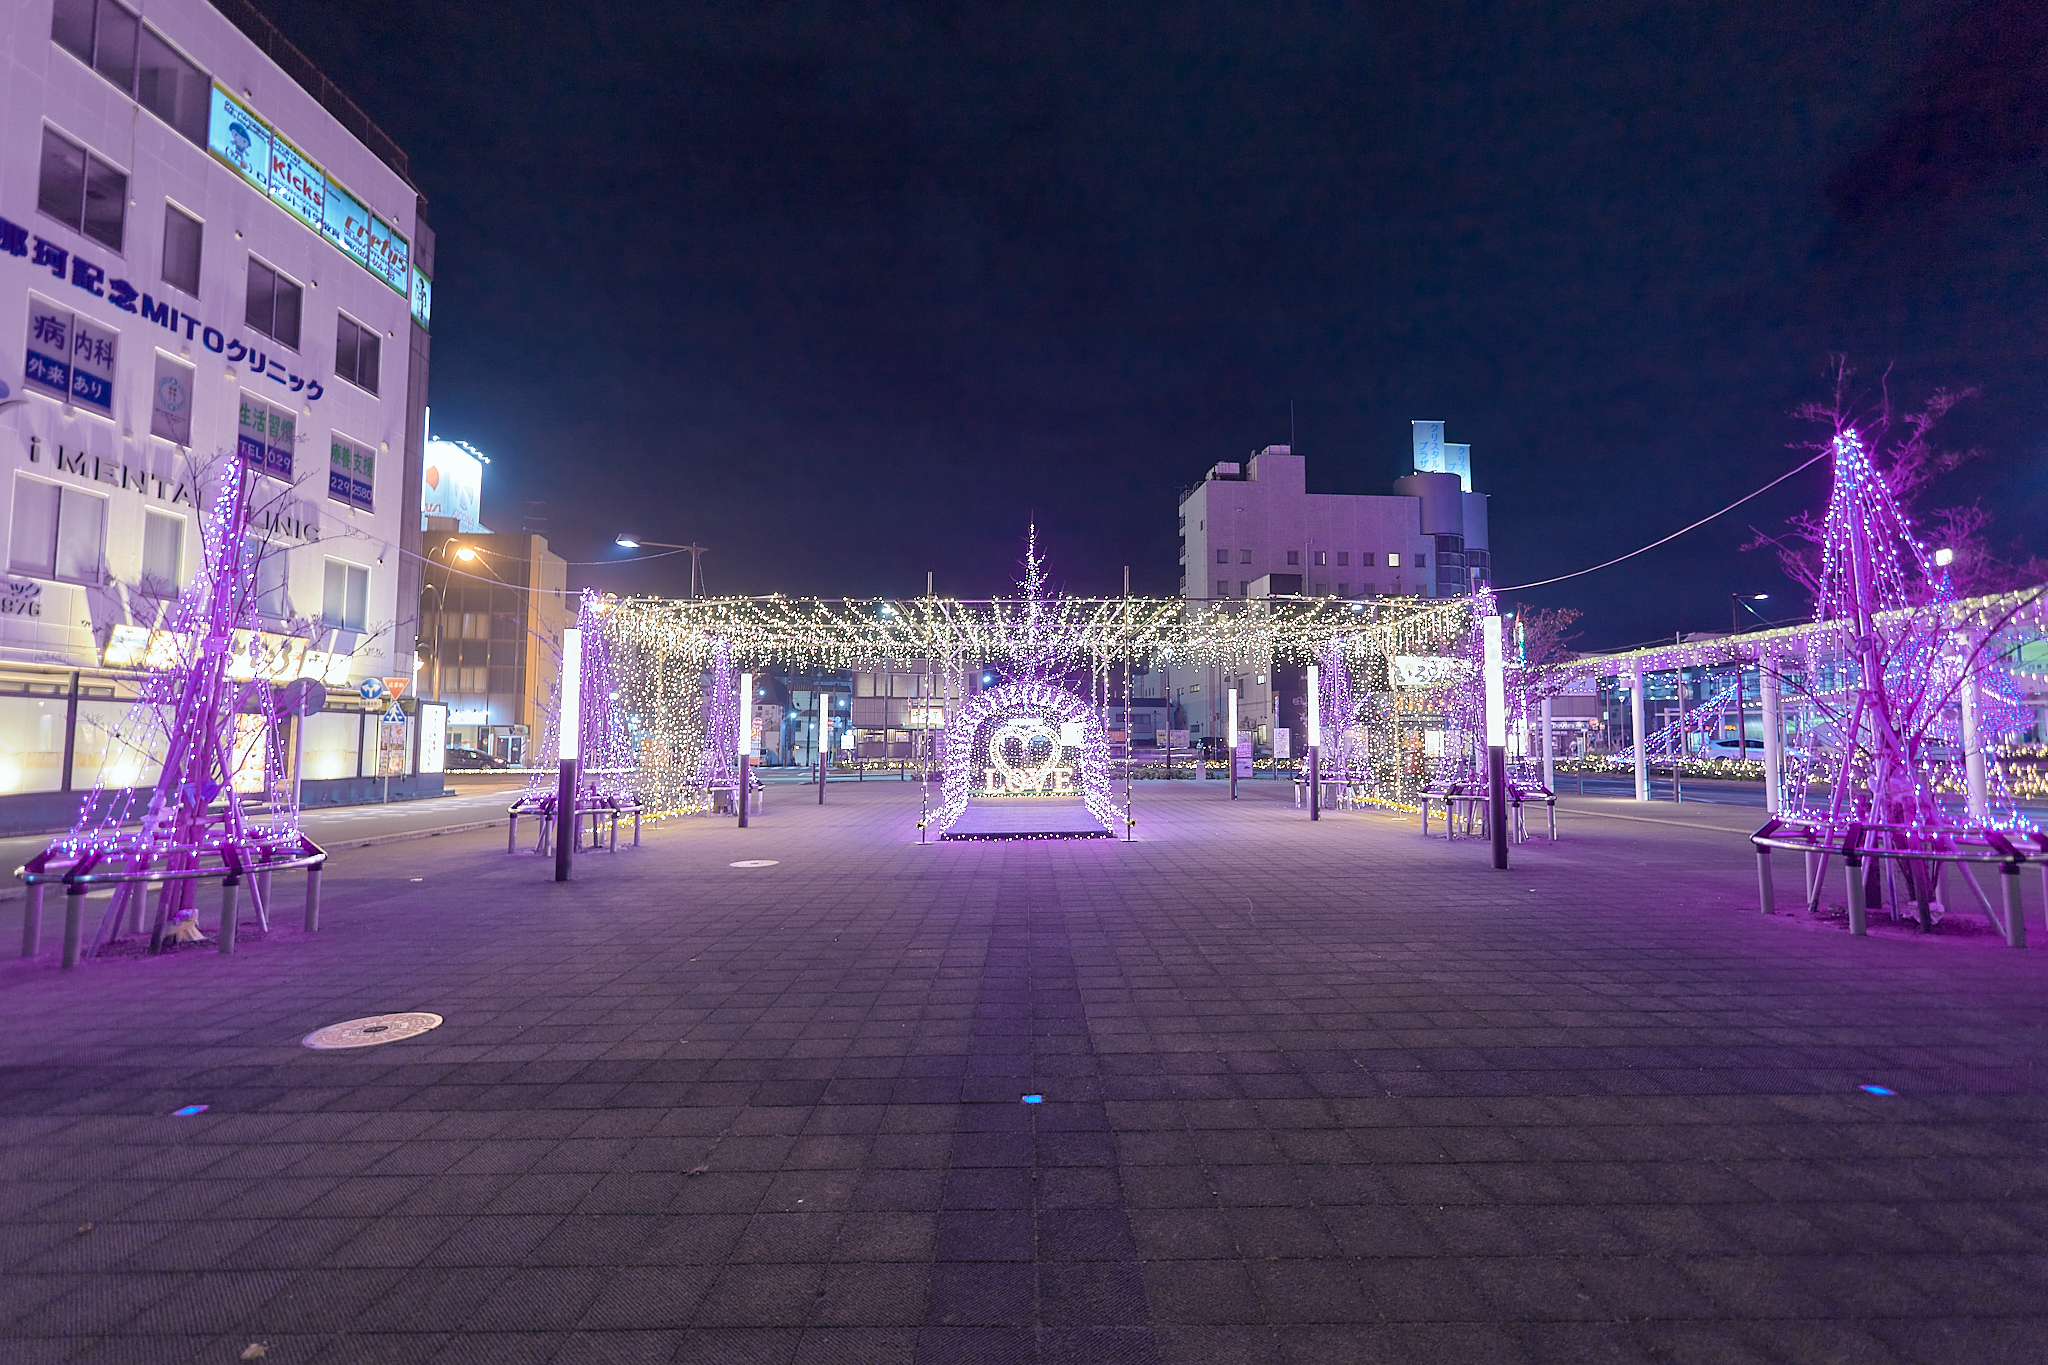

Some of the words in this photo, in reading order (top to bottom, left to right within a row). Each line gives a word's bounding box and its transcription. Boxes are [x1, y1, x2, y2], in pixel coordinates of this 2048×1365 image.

[273, 155, 322, 207] Kicks
[239, 439, 263, 460] TEL
[268, 450, 291, 470] 029
[1419, 441, 1429, 469] プラザ
[1430, 423, 1440, 469] クリスタル
[330, 476, 350, 494] 229
[351, 484, 373, 501] 2580
[247, 503, 320, 542] LINIC
[983, 766, 1074, 794] LOVE
